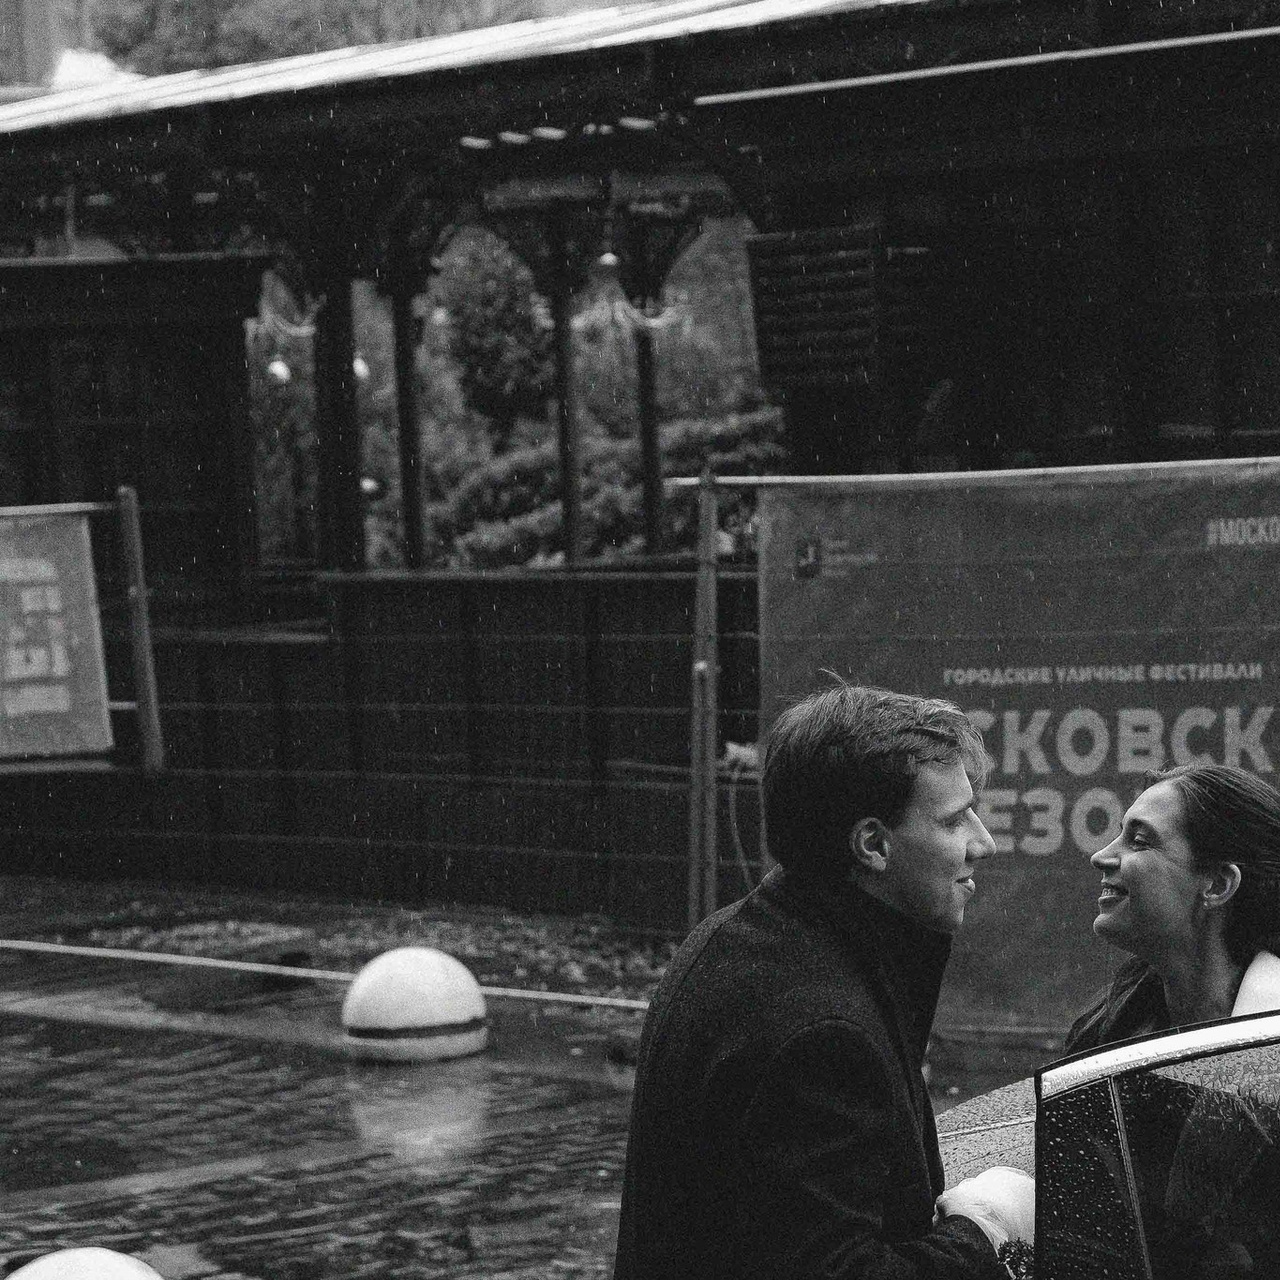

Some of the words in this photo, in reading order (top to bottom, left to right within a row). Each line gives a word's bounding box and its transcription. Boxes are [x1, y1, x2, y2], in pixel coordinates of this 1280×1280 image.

[943, 666, 1052, 686] ГОРОДСКИЕ
[1056, 664, 1145, 683] УЛИЧНЫЕ
[1149, 662, 1263, 682] ФЕСТИВАЛИ
